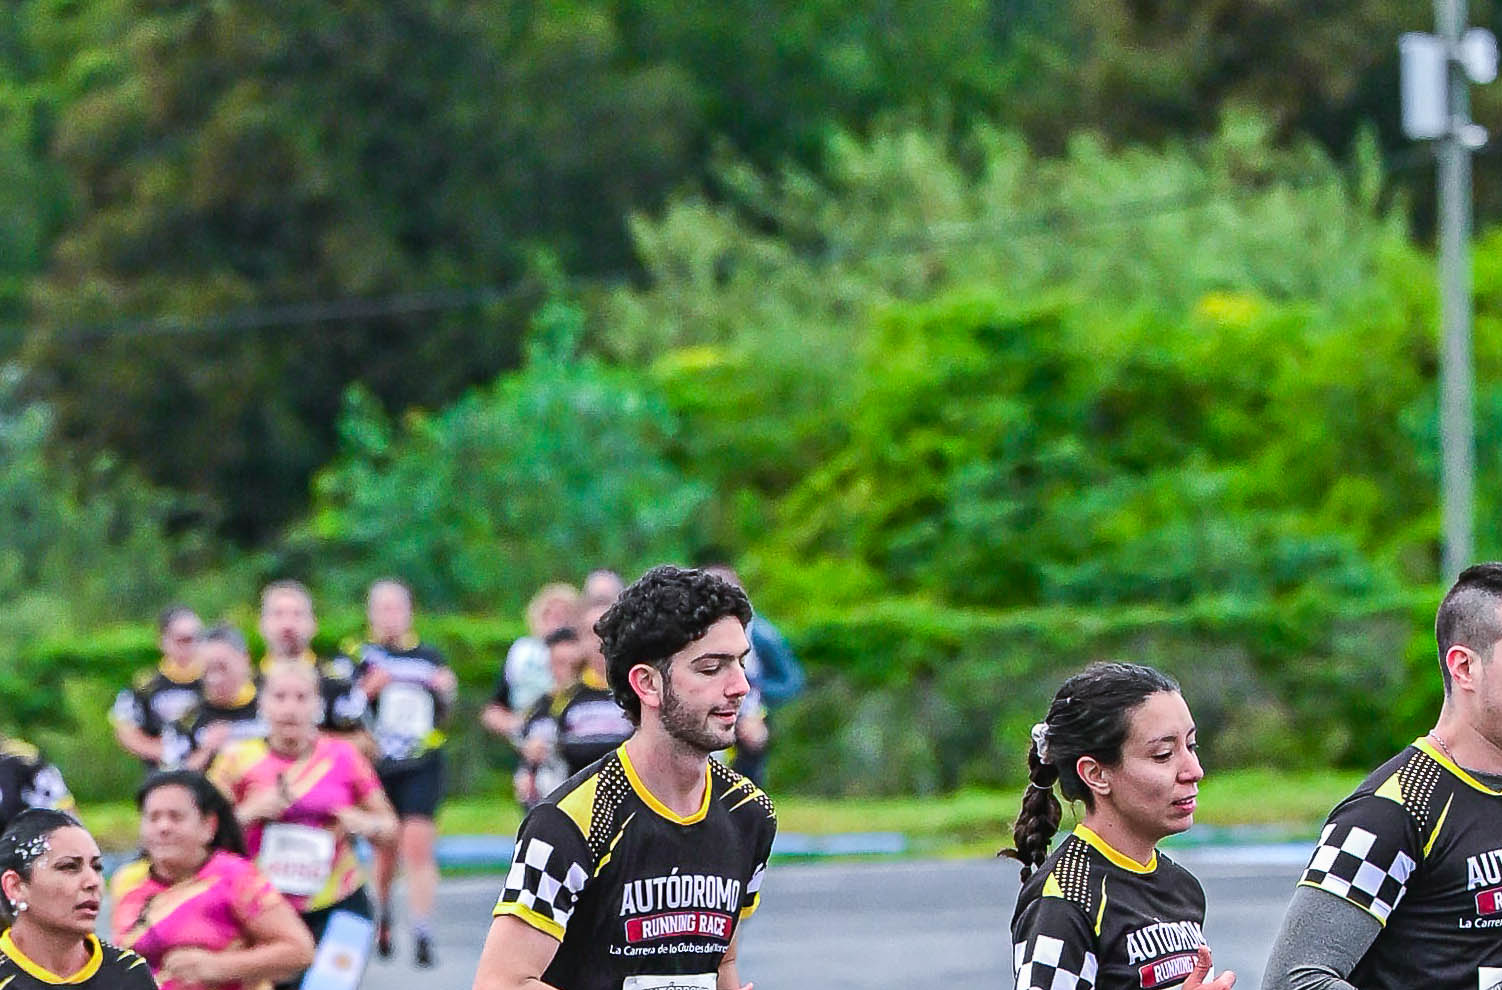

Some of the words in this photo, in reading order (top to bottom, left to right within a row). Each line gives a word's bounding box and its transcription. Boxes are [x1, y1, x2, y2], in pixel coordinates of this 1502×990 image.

[619, 867, 740, 917] AUTÓDROMO
[642, 914, 696, 939] RUNNING
[698, 914, 727, 937] RACE
[1459, 917, 1472, 928] La
[609, 944, 622, 955] La
[623, 945, 656, 956] Carrera
[657, 943, 669, 954] de
[1153, 956, 1194, 983] RUNNING
